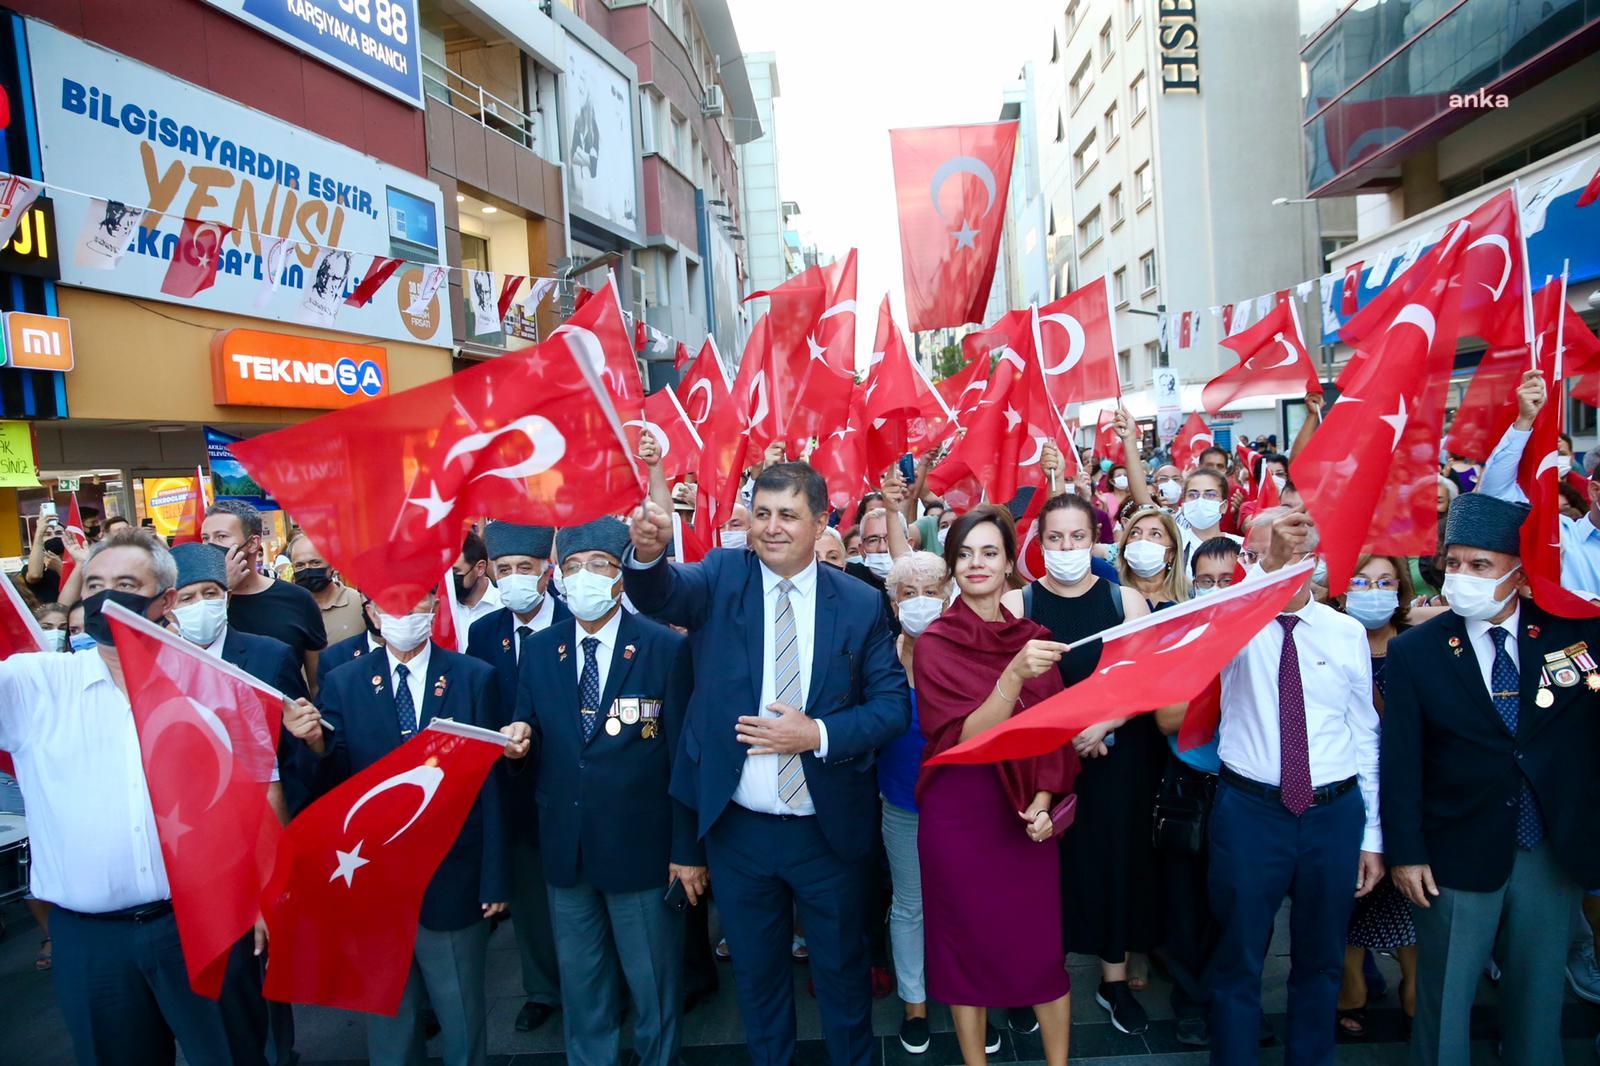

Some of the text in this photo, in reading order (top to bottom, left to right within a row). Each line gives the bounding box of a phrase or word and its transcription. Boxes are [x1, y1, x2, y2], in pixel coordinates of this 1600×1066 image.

[286, 0, 408, 75] KARŞIYAKA BRANCH
[375, 0, 408, 45] 88
[232, 353, 382, 388] TEKNOSA
